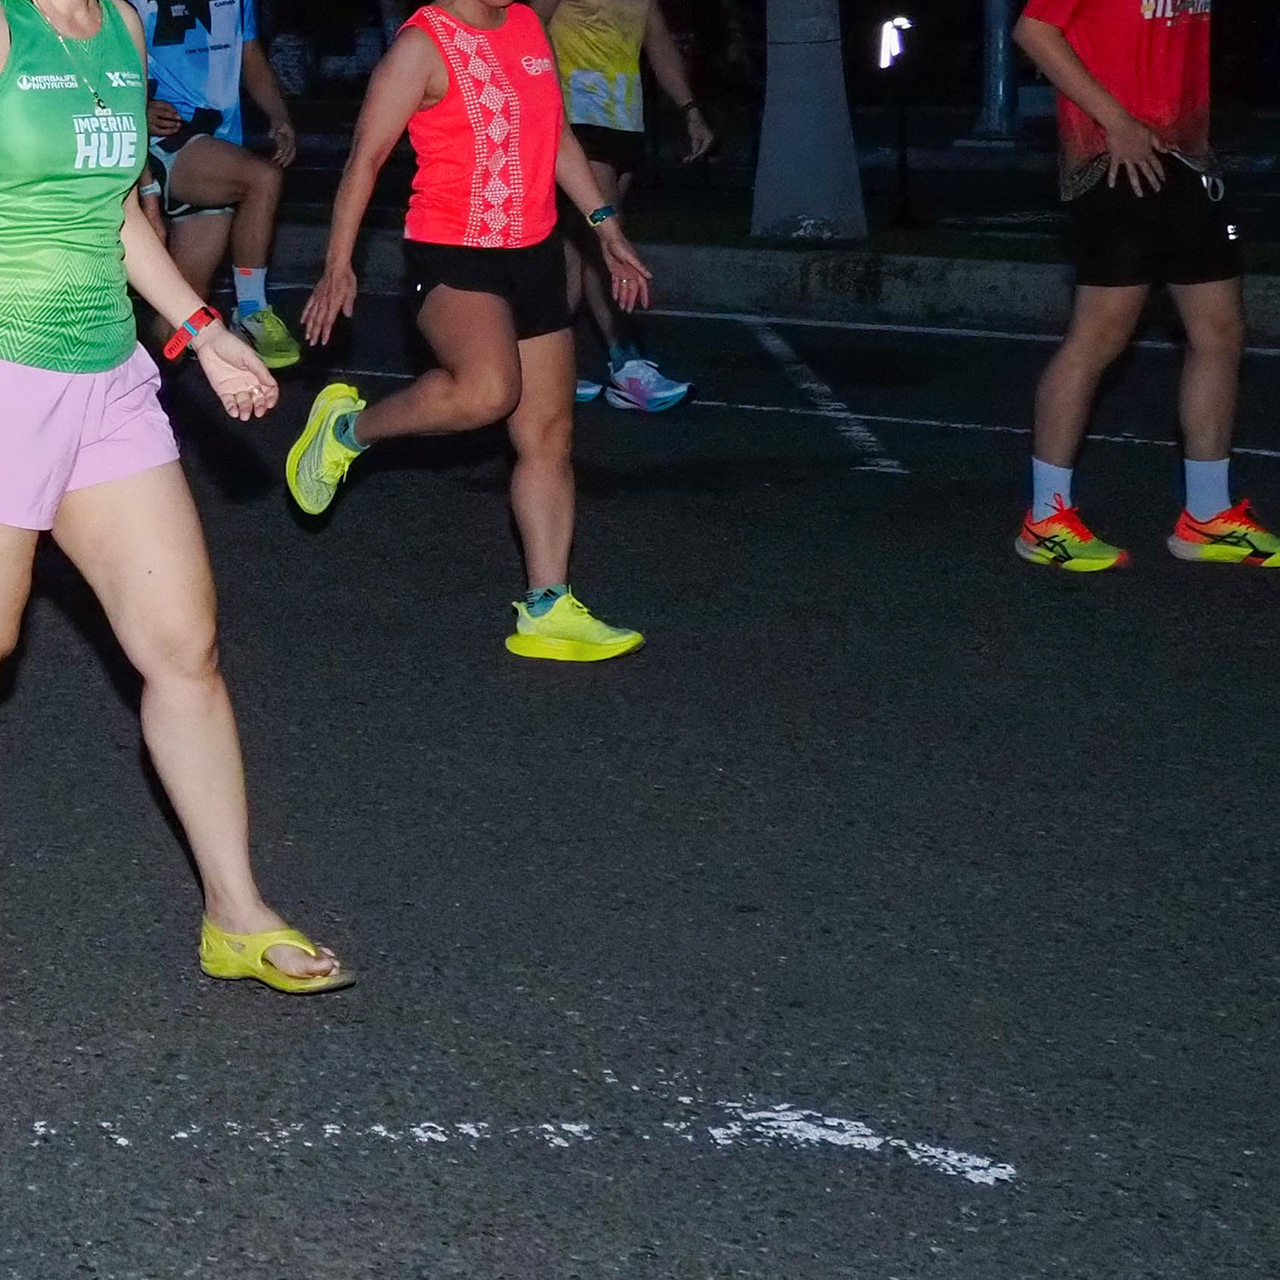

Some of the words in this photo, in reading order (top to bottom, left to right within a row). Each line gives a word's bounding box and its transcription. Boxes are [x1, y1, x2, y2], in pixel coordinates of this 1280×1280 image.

[30, 74, 77, 83] HERBALIFE
[32, 81, 79, 90] NUTRITION
[72, 115, 138, 134] IMPERIAL
[73, 131, 138, 170] HUE
